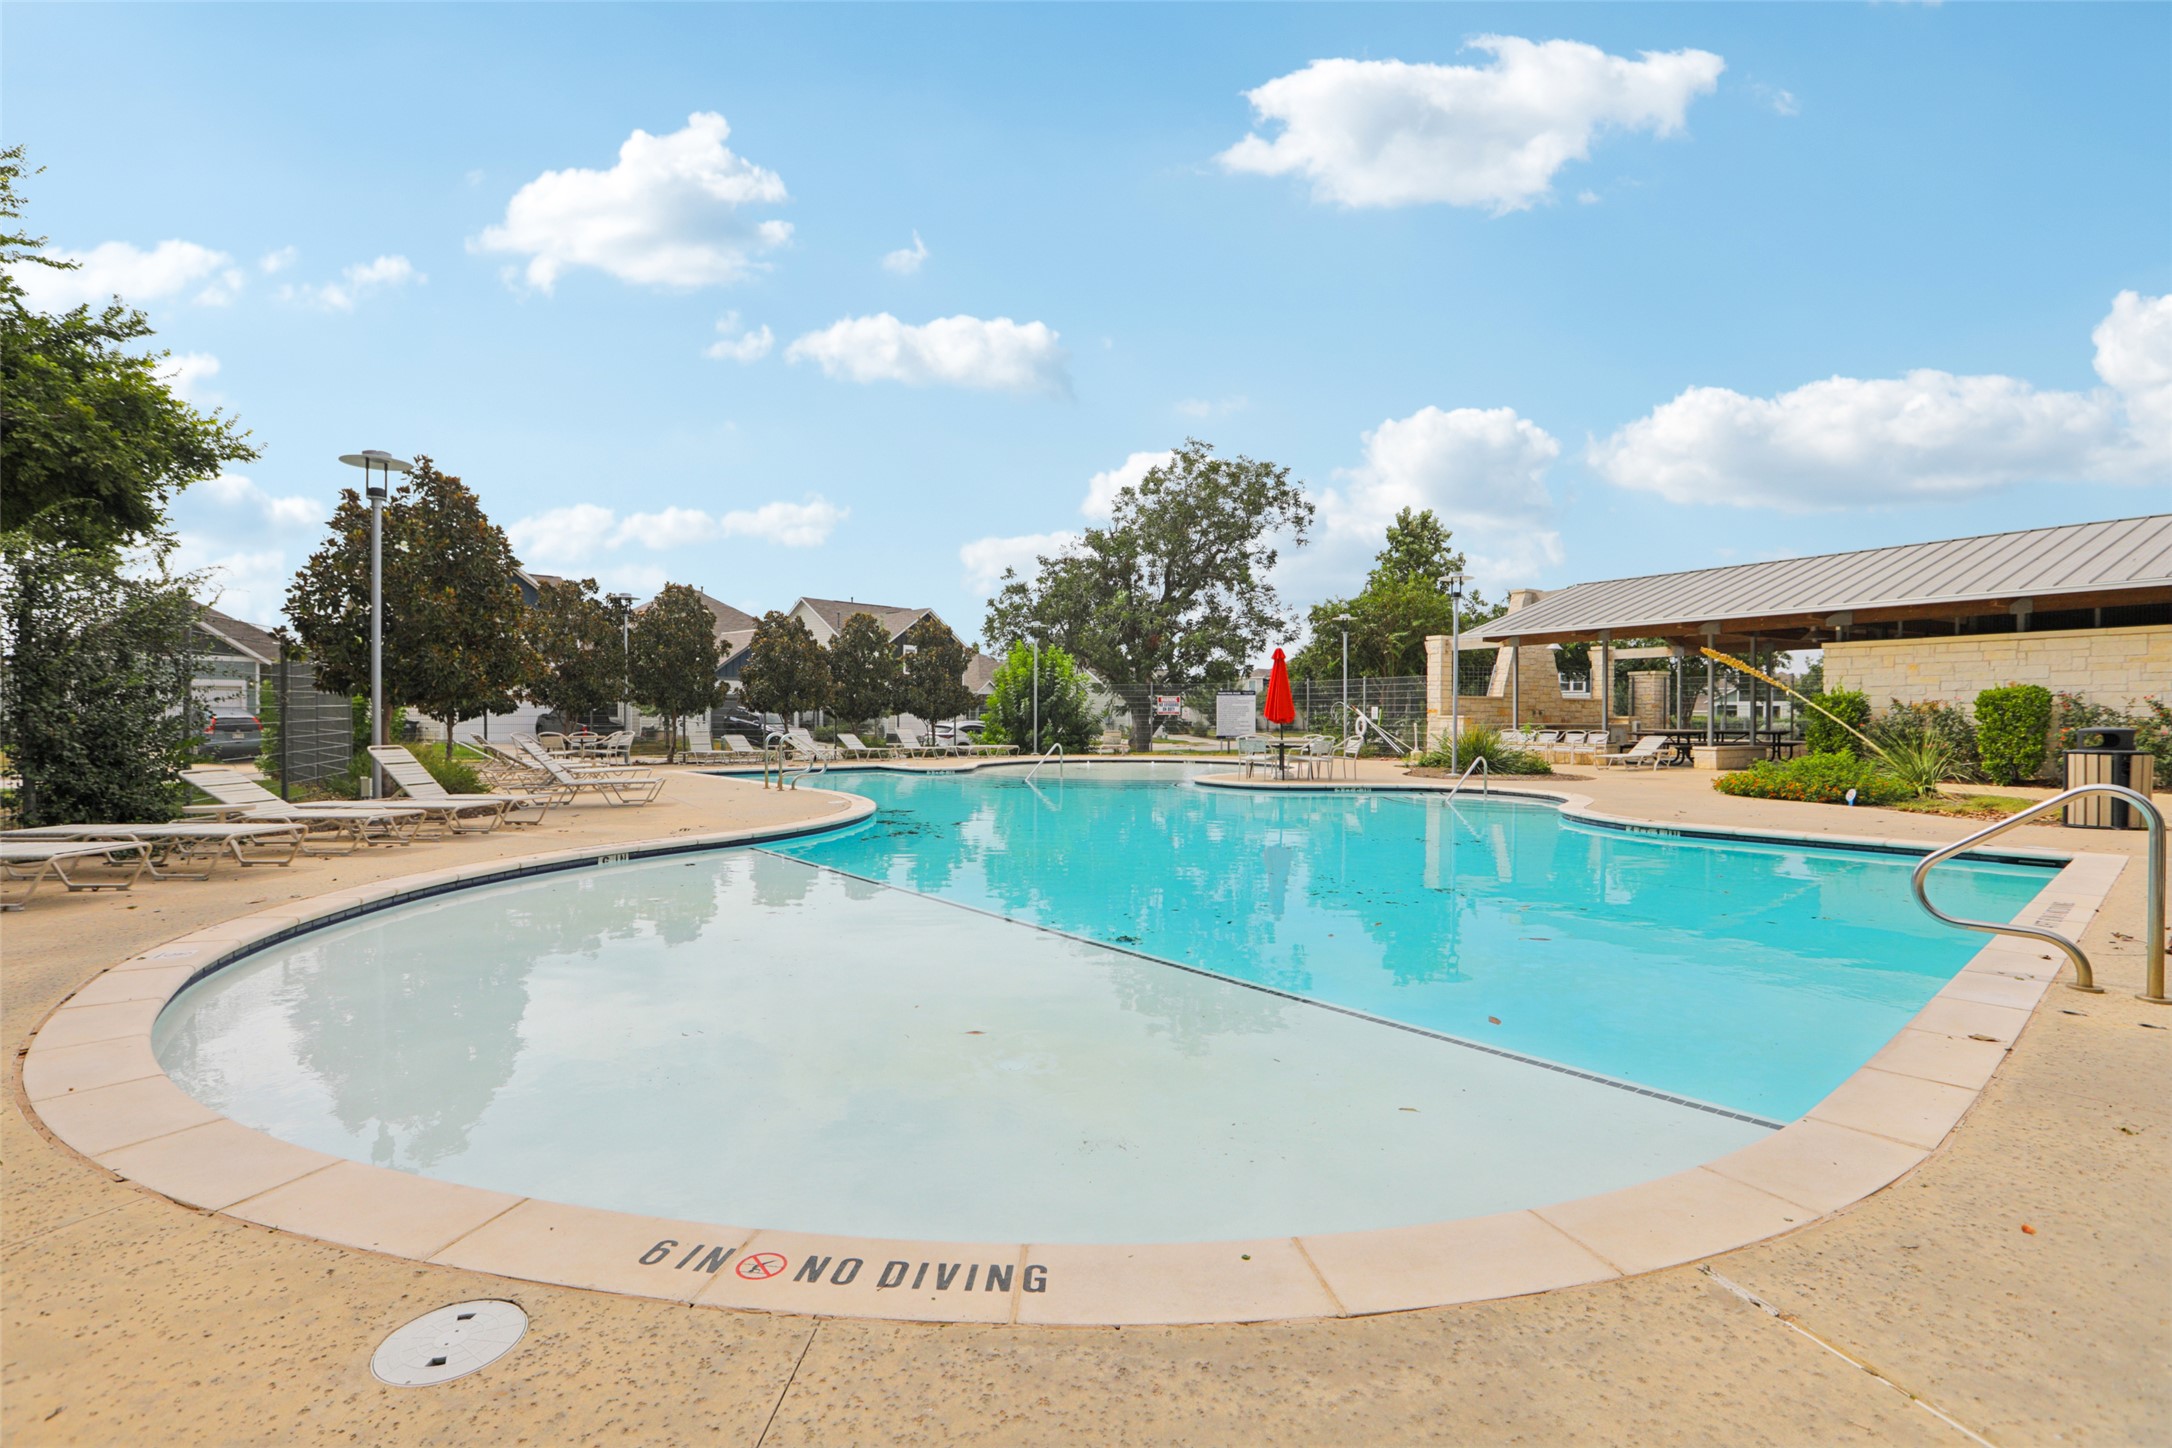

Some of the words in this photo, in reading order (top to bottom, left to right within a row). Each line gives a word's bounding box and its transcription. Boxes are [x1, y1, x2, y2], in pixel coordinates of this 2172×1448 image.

[638, 1239, 679, 1266] 6
[674, 1244, 737, 1274] IN
[792, 1255, 864, 1286] NO
[876, 1260, 1048, 1293] DIVING
